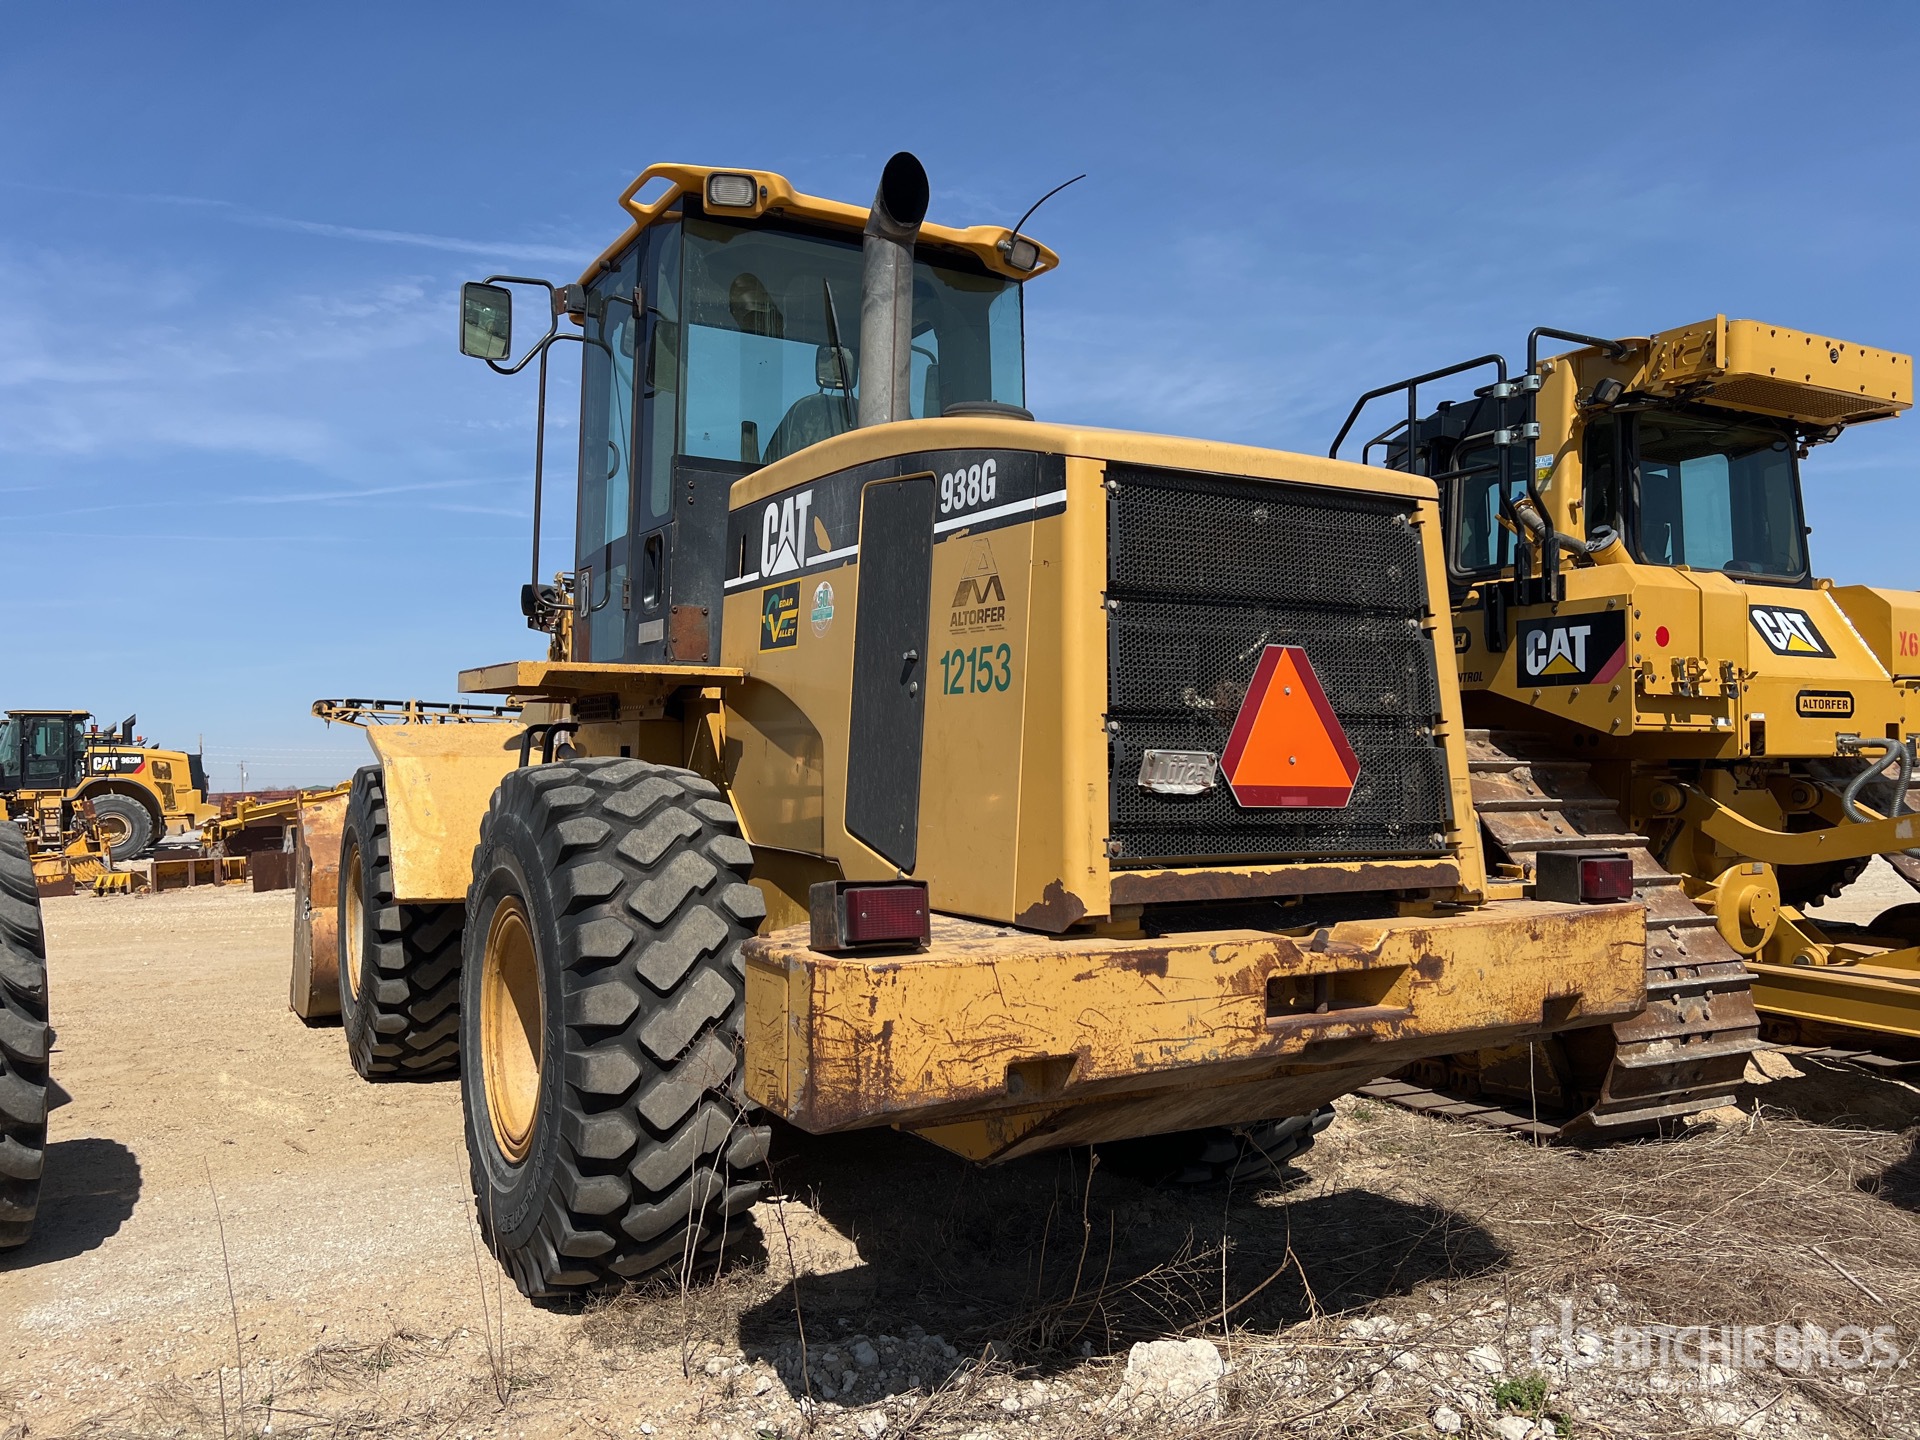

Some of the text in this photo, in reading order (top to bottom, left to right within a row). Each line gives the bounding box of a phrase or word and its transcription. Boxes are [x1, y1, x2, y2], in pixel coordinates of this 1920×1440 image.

[940, 459, 997, 514] 938G
[761, 489, 813, 578] CAT
[950, 605, 1006, 628] ALTORFER
[1750, 607, 1824, 653] CAT
[940, 643, 1012, 695] 12153
[1526, 625, 1591, 676] CAT
[1802, 699, 1849, 710] ALTORFER
[93, 757, 118, 771] CAT
[121, 756, 142, 764] 962M
